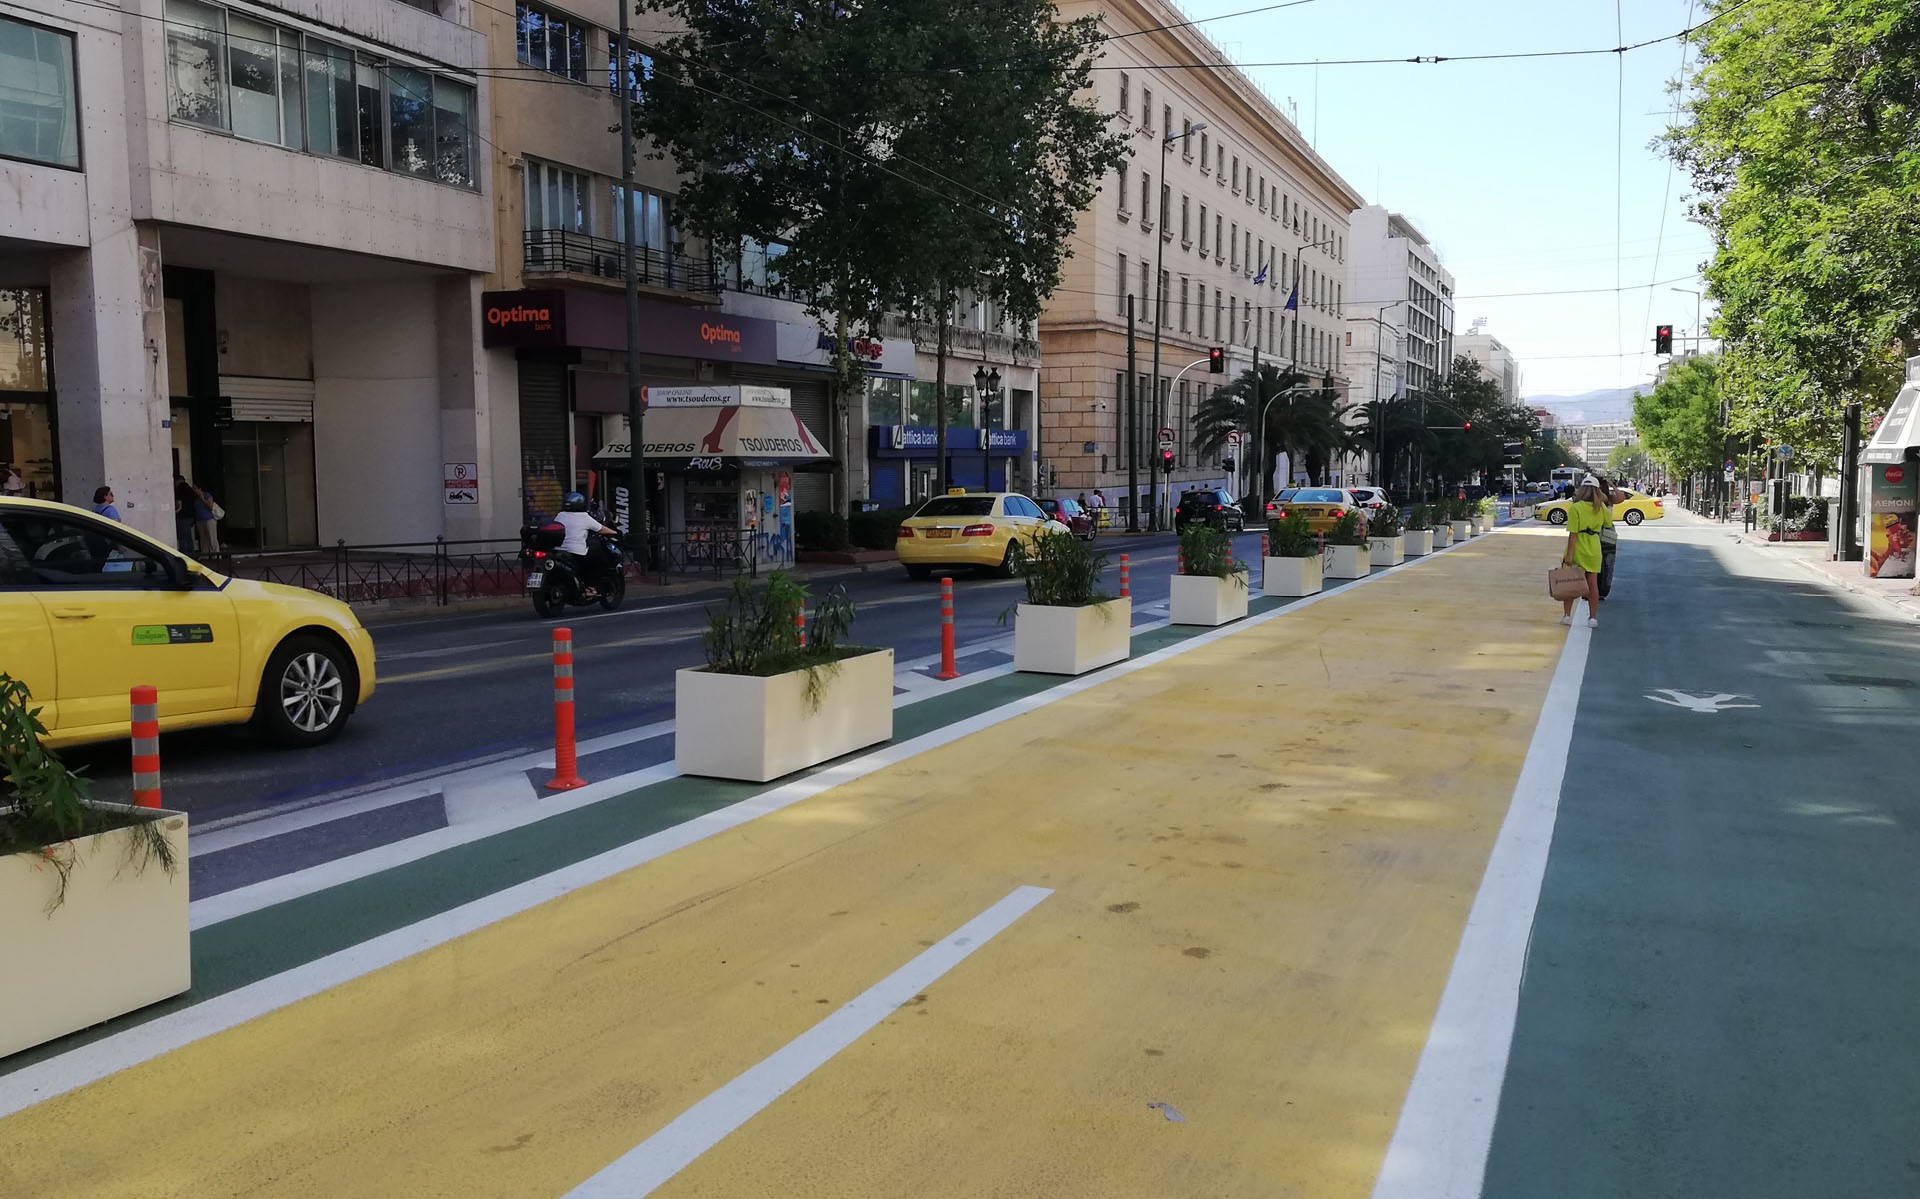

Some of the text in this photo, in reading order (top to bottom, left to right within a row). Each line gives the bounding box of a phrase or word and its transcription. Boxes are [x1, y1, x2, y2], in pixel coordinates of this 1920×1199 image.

[487, 305, 549, 327] Optima
[701, 323, 740, 344] Optima
[666, 394, 731, 404] www.tsouderos.gr
[903, 430, 921, 445] attica
[921, 430, 938, 445] bank
[1003, 432, 1016, 446] bank
[608, 443, 695, 453] TSODEROS
[739, 438, 802, 452] TSOUDEROS
